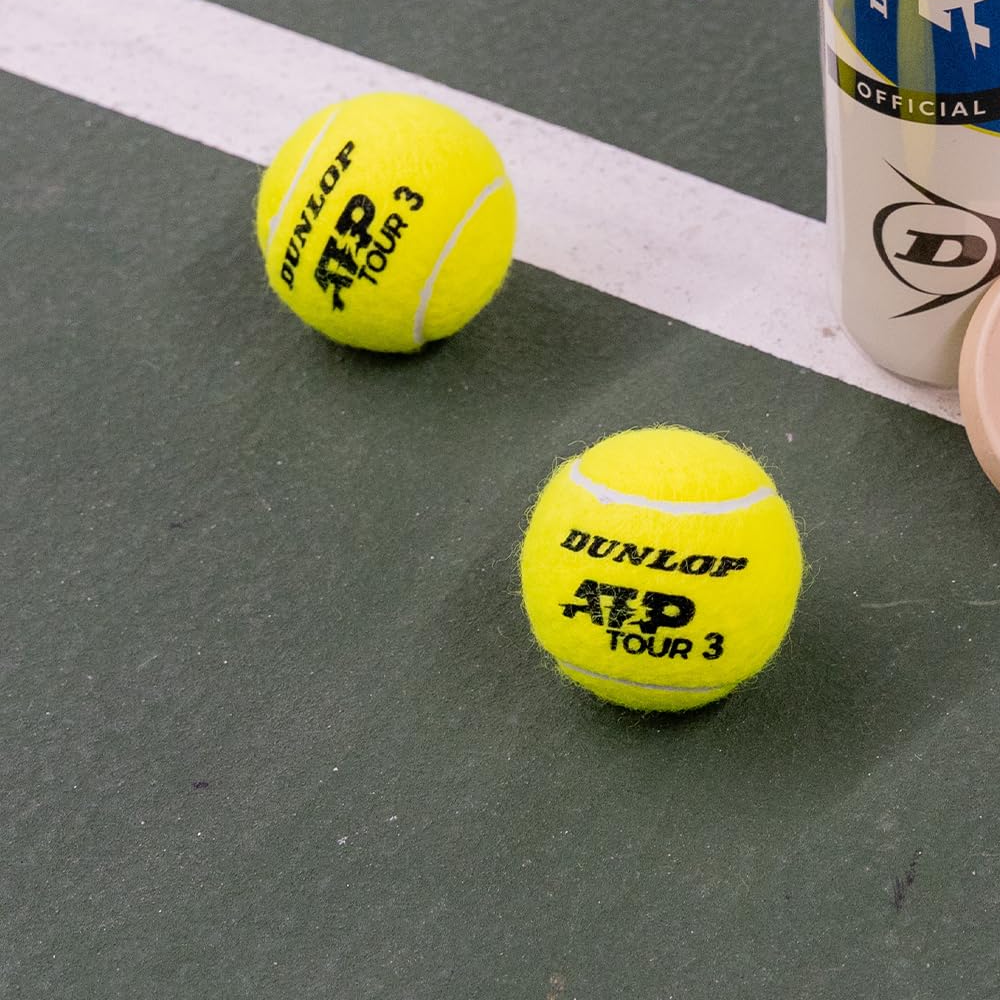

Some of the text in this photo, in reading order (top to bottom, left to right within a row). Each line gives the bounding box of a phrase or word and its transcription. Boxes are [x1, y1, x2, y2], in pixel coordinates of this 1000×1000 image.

[857, 81, 986, 118] OFFICIAL
[279, 140, 356, 291] DUNLOP
[358, 185, 425, 286] TOUR 3
[314, 193, 376, 312] ATP
[560, 528, 748, 578] DUNLOP
[558, 579, 696, 634] ATP
[606, 629, 725, 660] TOUR 3
